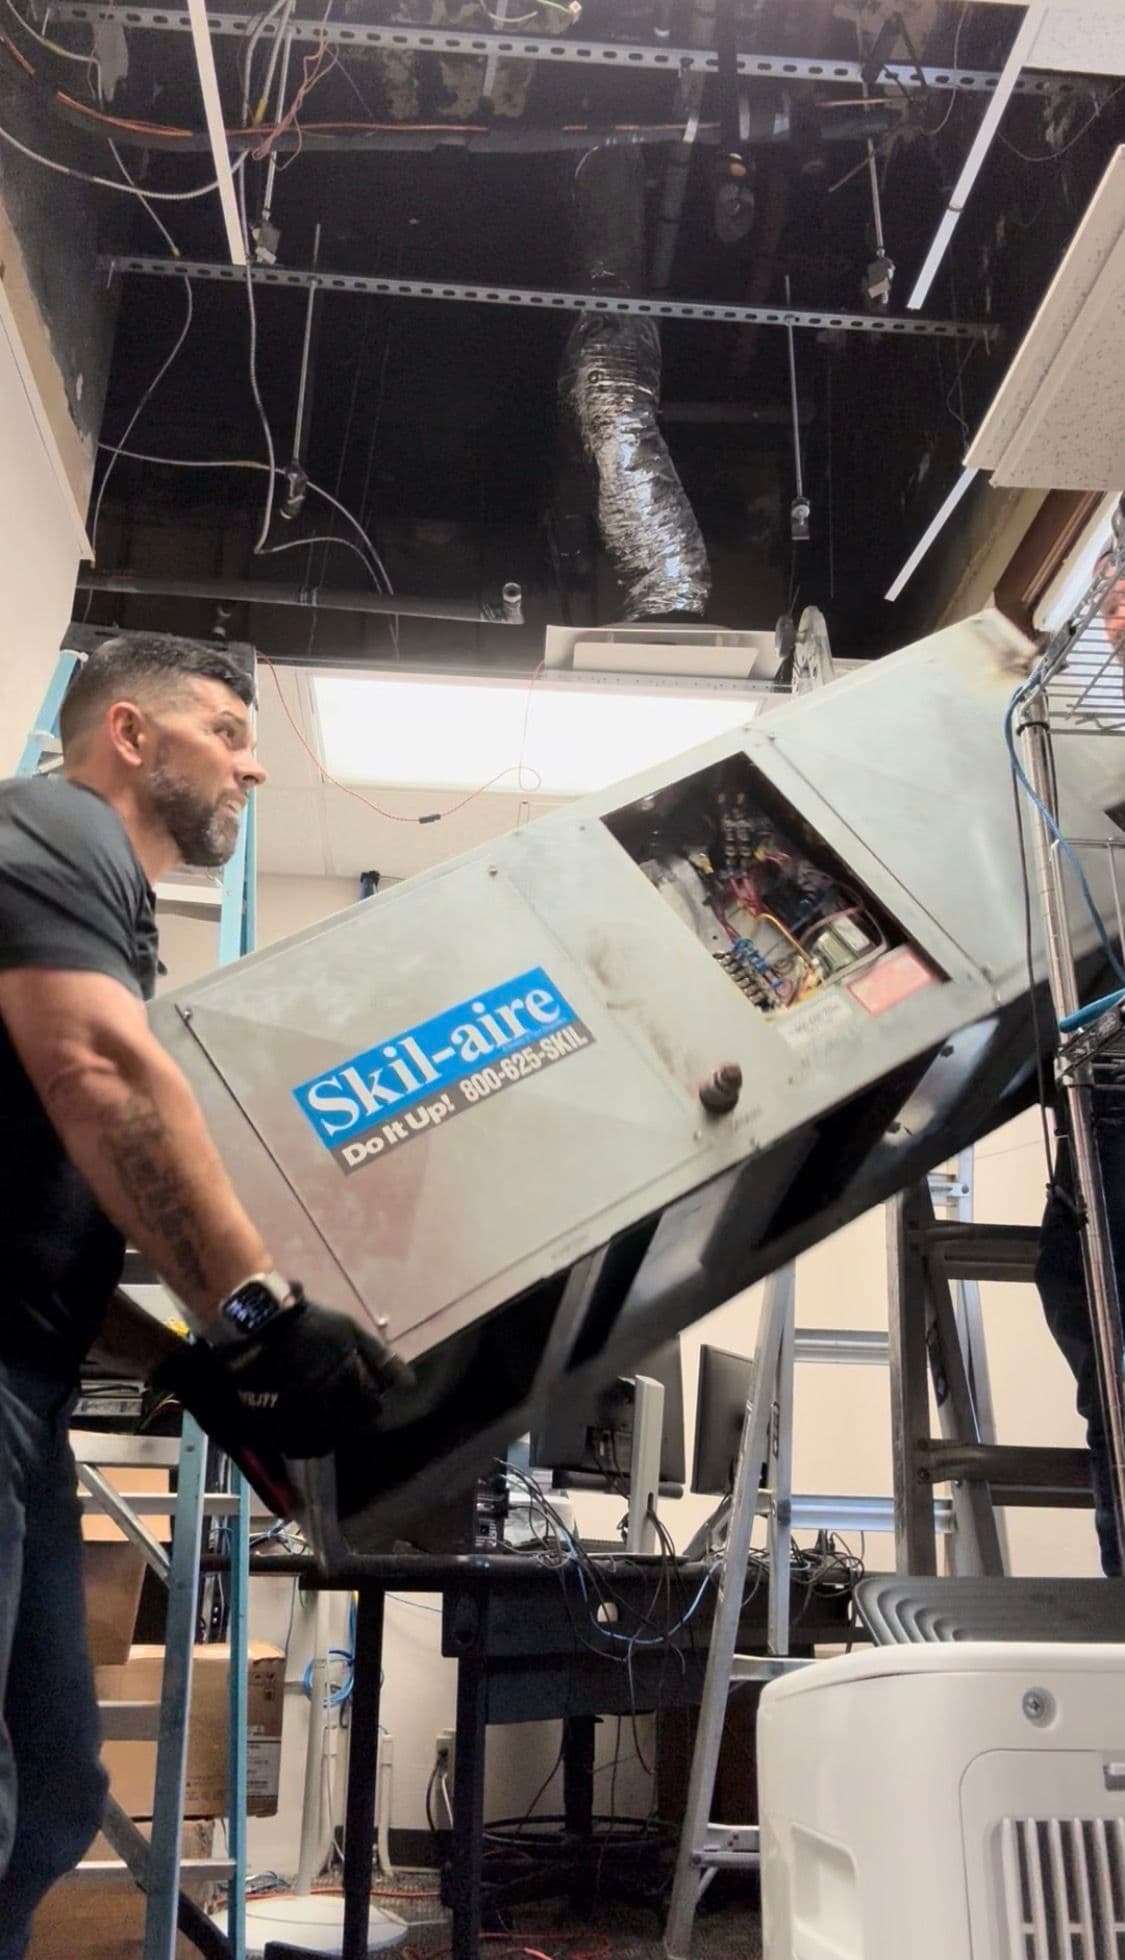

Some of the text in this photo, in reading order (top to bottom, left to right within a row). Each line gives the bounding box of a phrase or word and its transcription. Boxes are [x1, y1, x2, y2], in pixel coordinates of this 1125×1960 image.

[307, 988, 561, 1136] Skil-aire
[341, 1136, 385, 1167] Do
[382, 1120, 409, 1145] It
[404, 1093, 456, 1125] Up!
[459, 1025, 589, 1103] 800-625-SKIL
